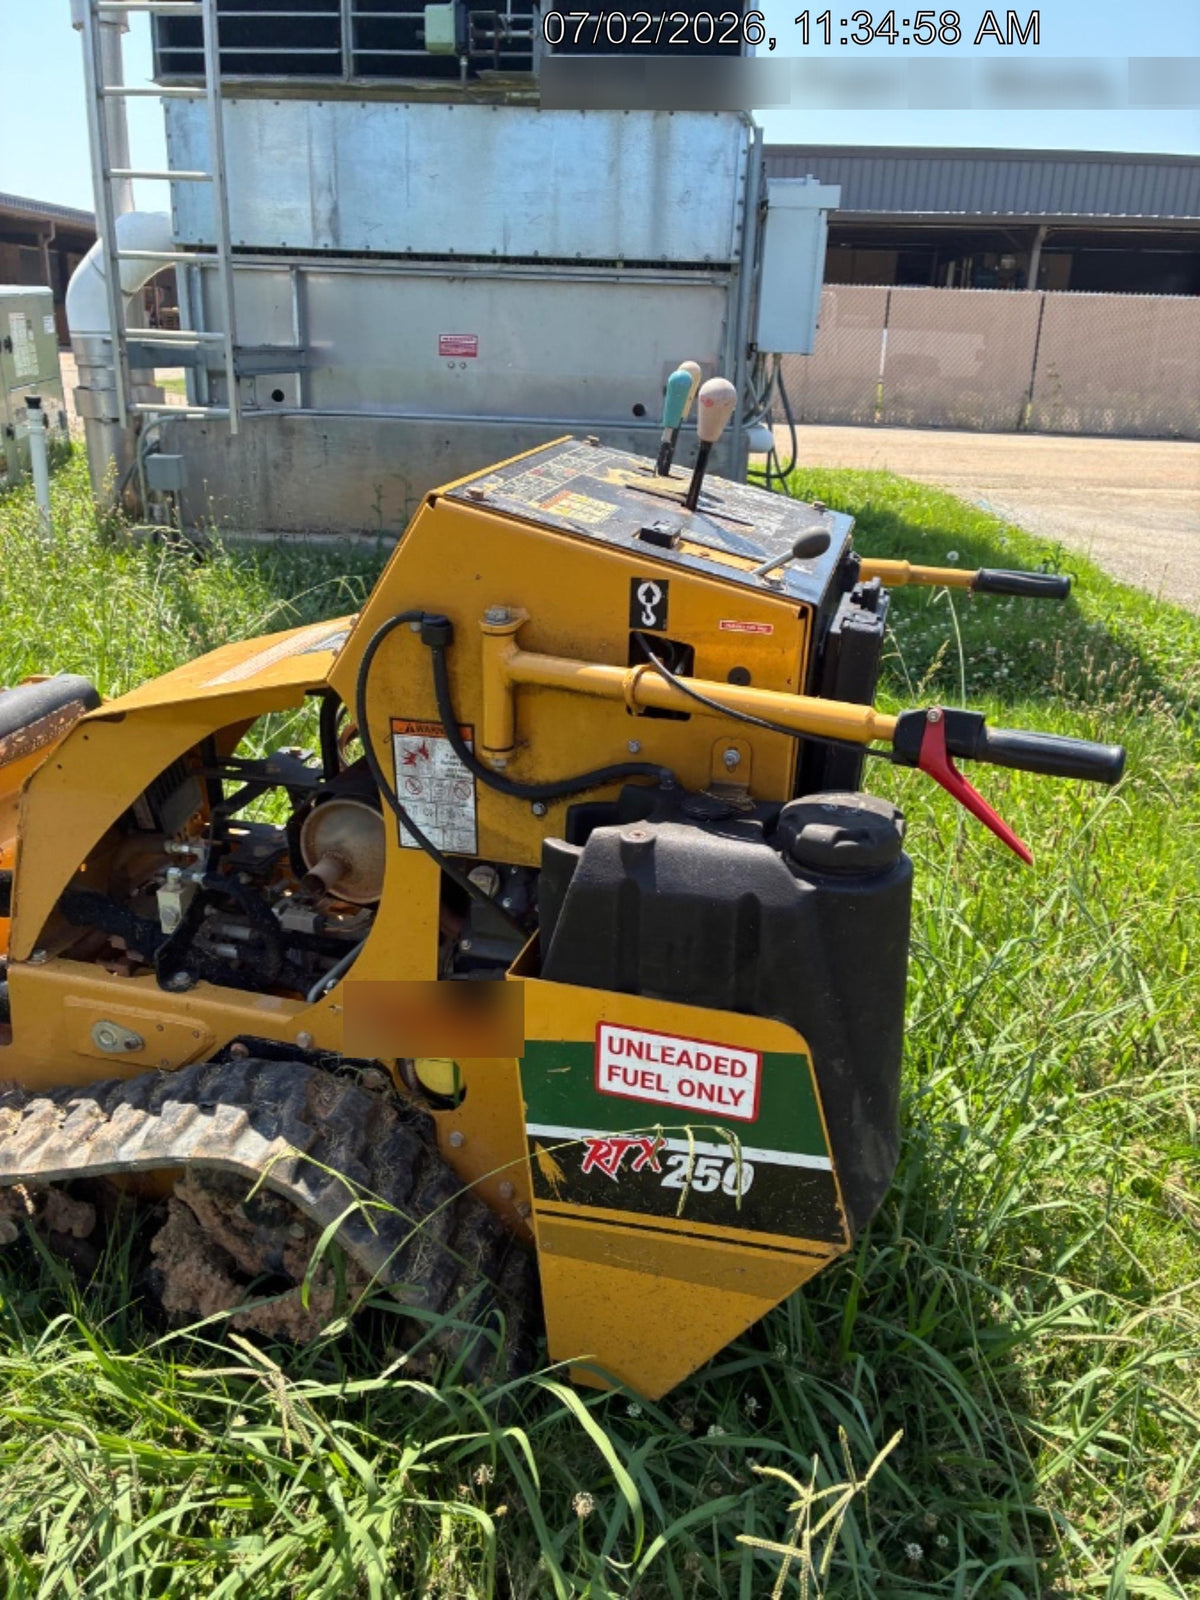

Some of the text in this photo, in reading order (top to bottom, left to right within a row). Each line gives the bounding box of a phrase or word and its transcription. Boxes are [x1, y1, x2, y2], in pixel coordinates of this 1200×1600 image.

[607, 1035, 748, 1078] UNLEADED
[607, 1064, 746, 1107] FUEL ONLY
[581, 1137, 755, 1197] RTX 250
